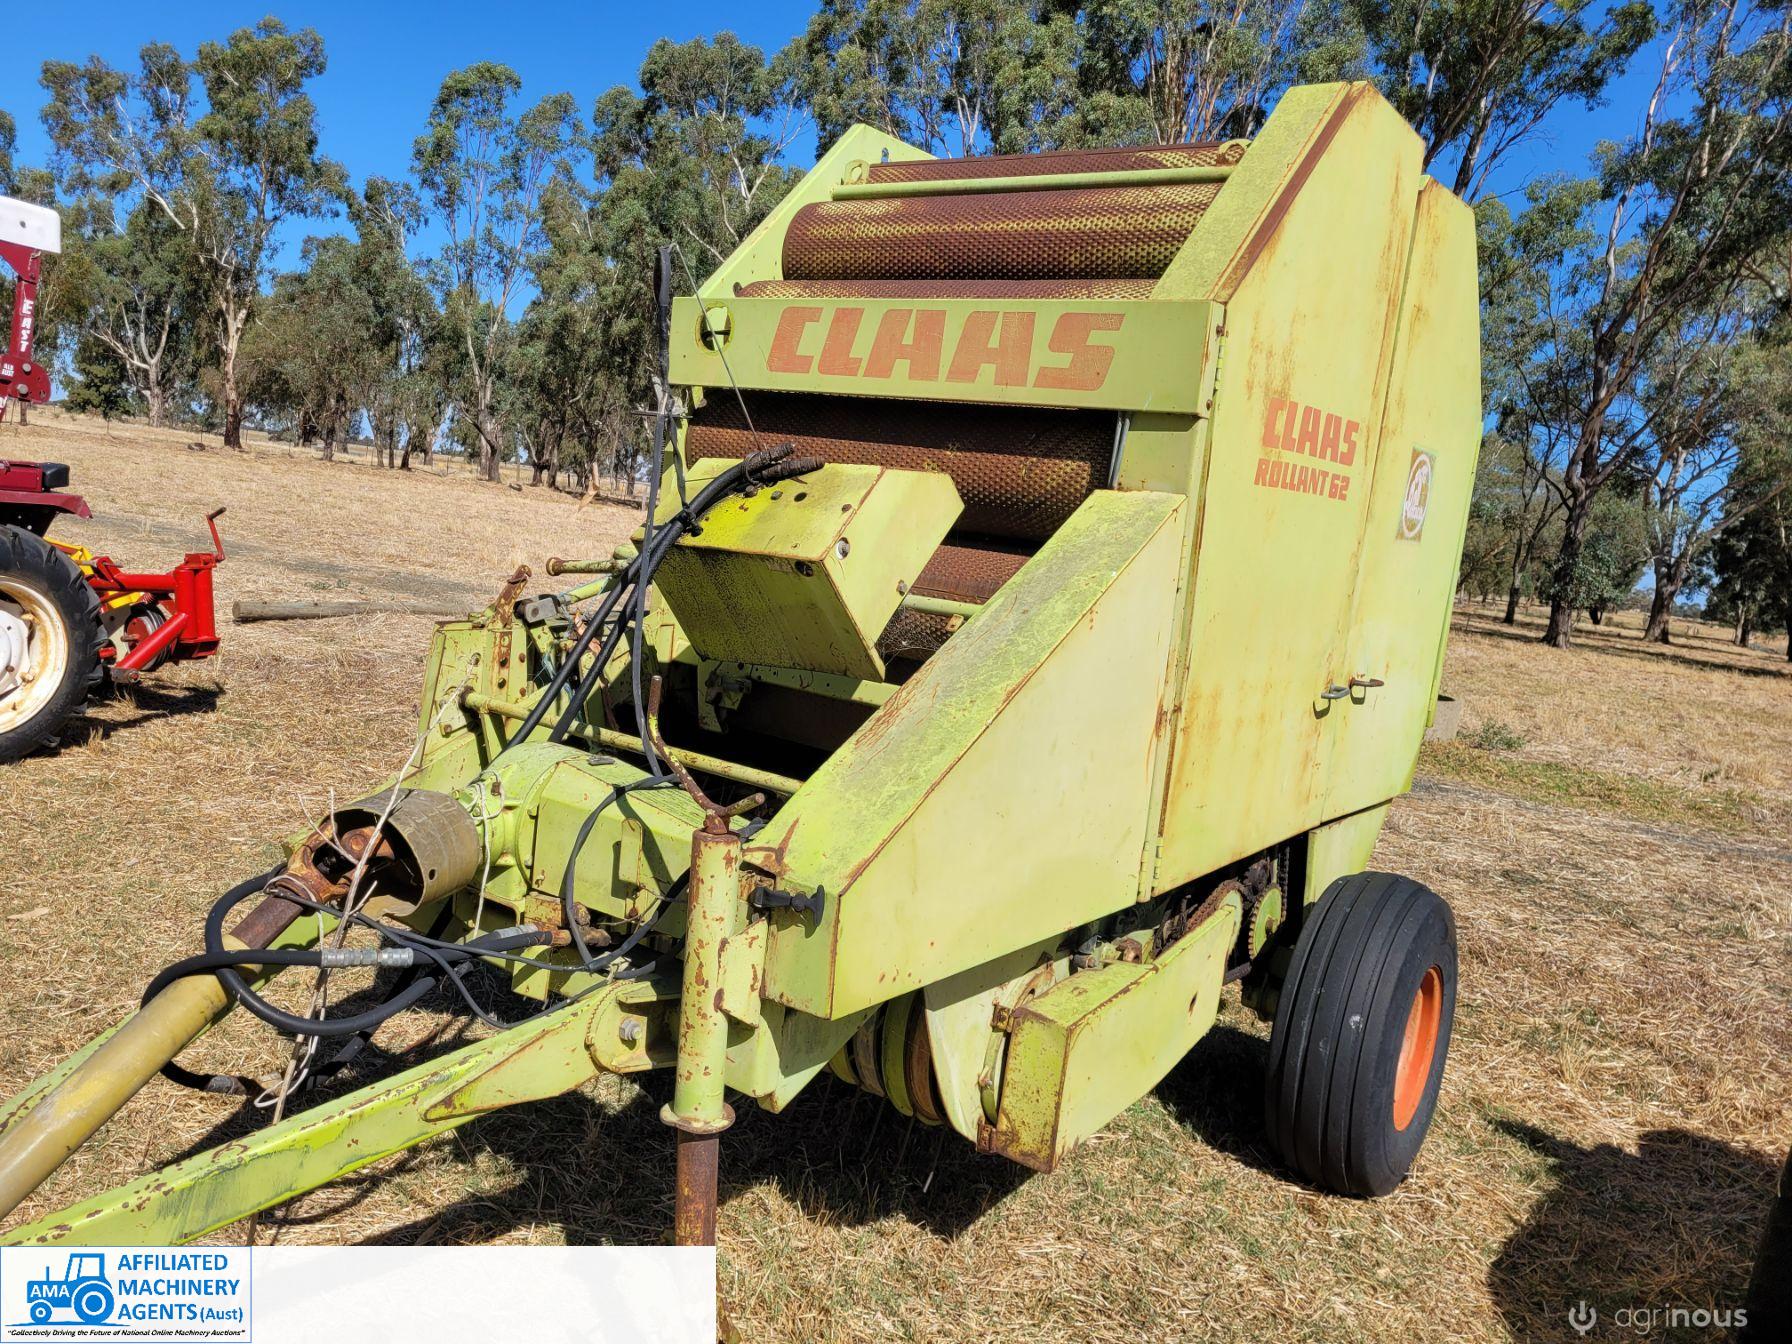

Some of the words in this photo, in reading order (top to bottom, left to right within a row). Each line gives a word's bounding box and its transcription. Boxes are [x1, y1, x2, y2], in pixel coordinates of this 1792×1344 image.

[20, 299, 34, 352] EAST
[767, 306, 1125, 391] CLAAS
[1262, 397, 1360, 467] CLAAS
[1254, 458, 1329, 496] ROLLANT
[1328, 474, 1350, 501] 62
